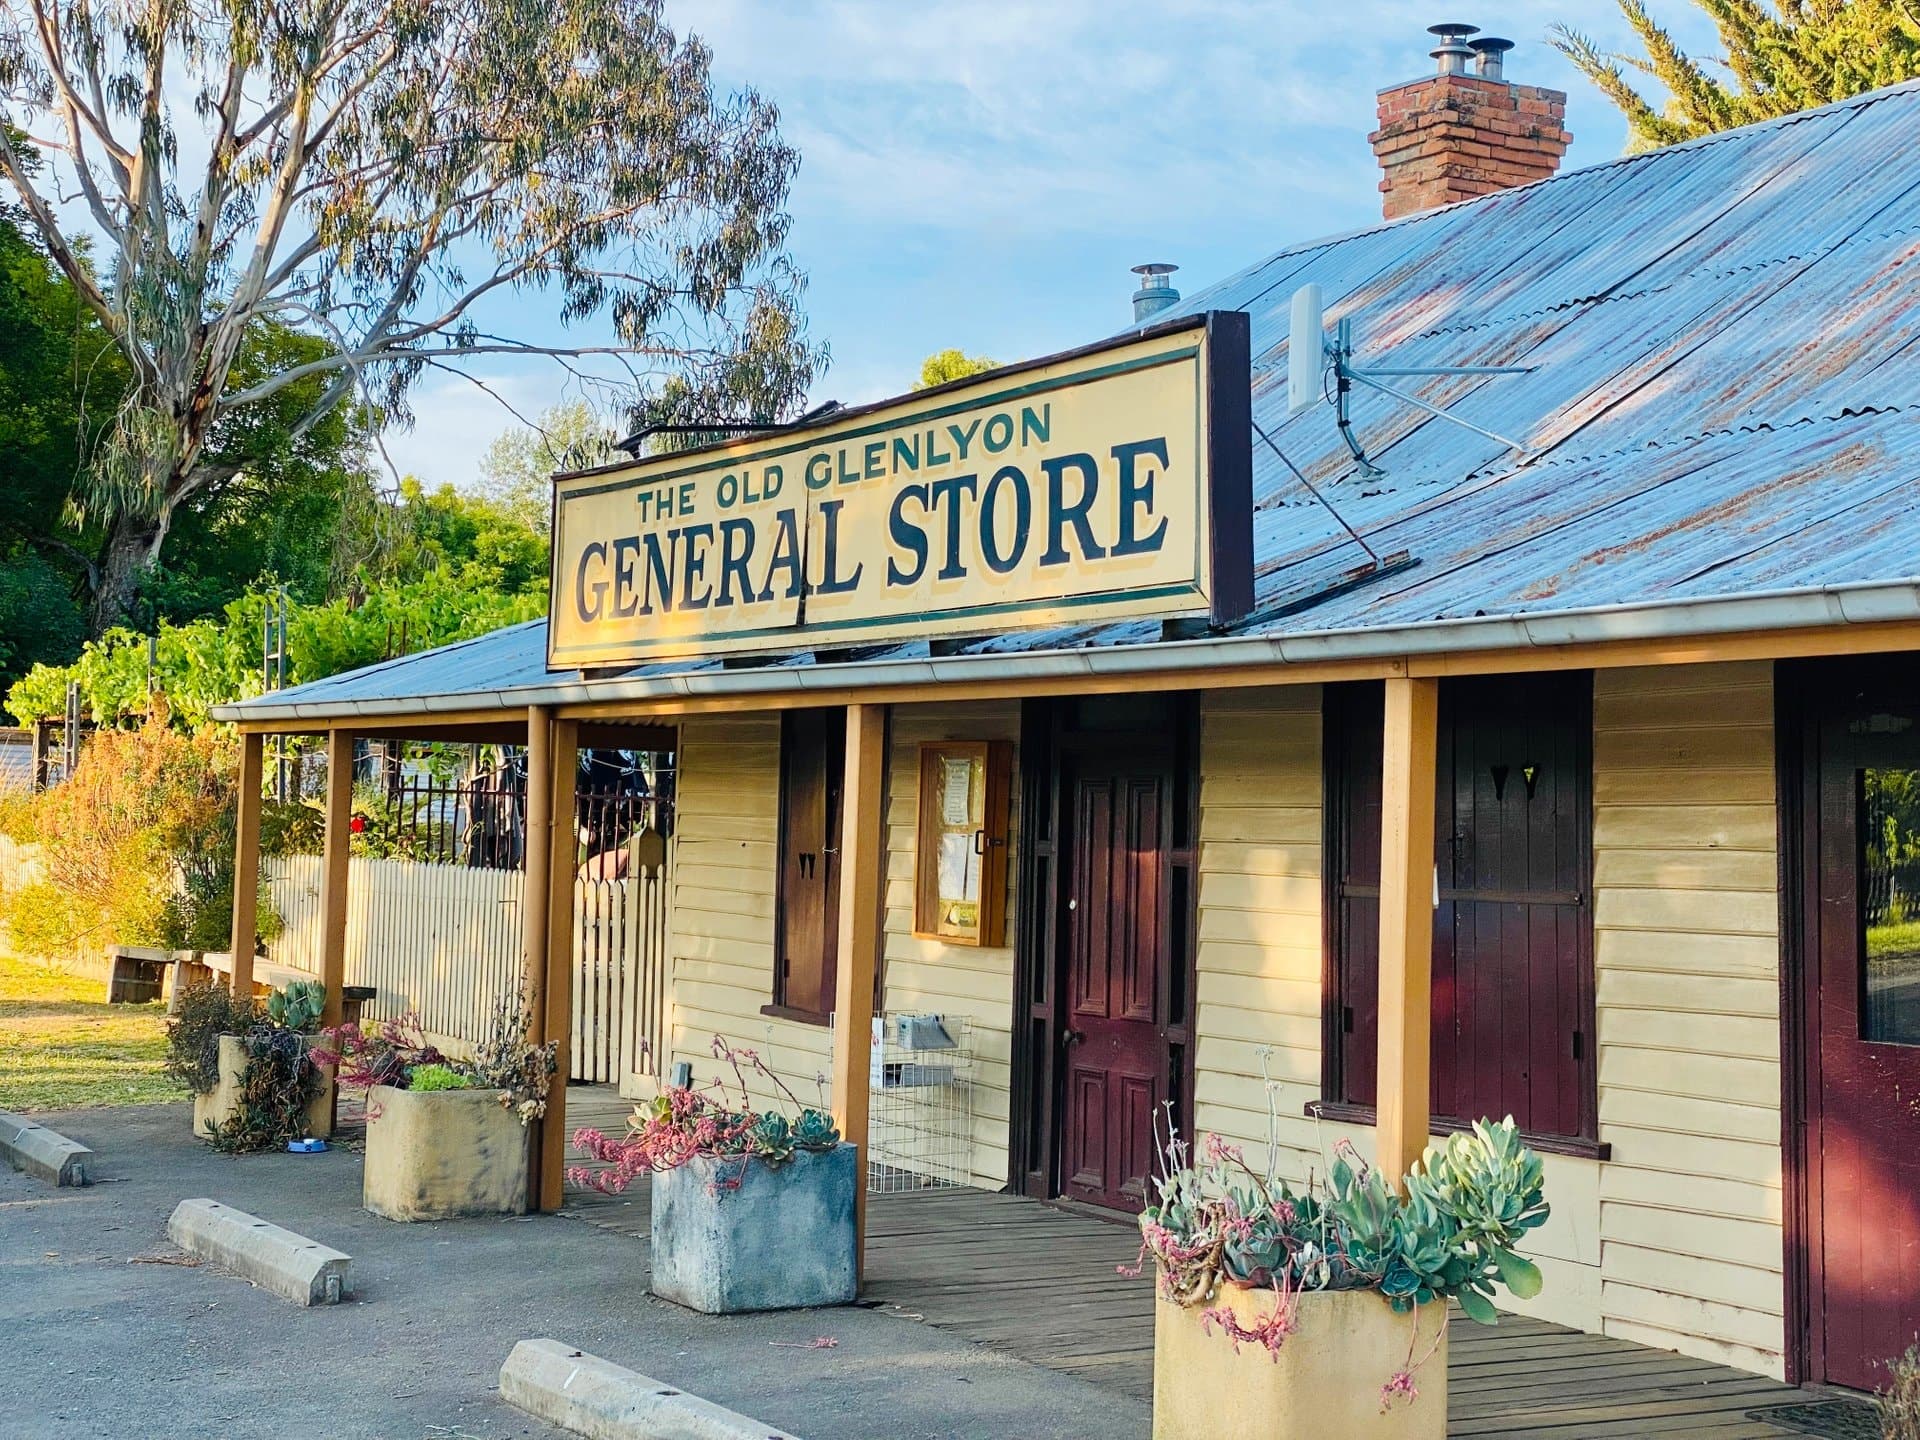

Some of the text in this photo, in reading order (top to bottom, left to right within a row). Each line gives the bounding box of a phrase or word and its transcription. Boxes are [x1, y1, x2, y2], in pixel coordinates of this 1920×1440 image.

[575, 436, 1170, 623] GENERAL STORE
[637, 402, 1051, 523] THE OLD GLENLYON
